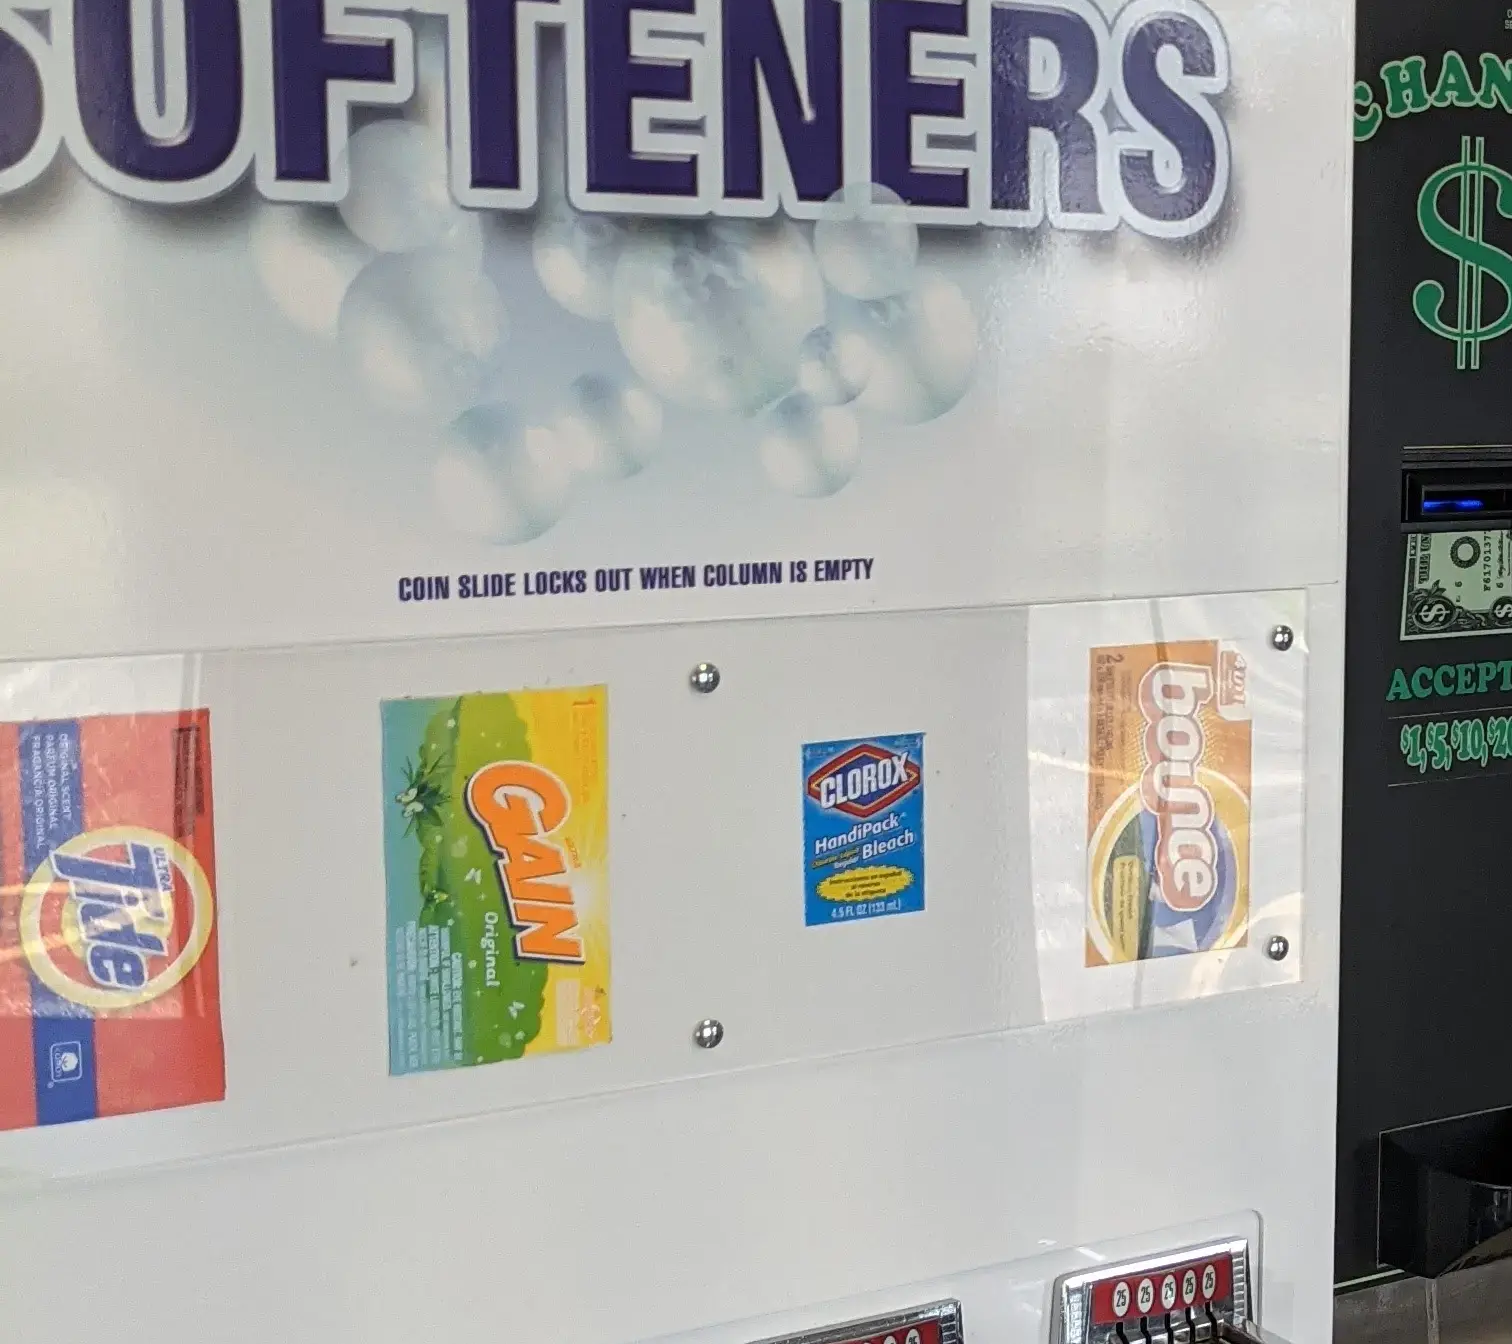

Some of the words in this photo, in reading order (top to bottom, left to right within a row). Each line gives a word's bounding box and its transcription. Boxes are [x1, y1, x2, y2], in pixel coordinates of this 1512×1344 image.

[398, 575, 450, 601] COIN
[458, 572, 516, 599] SLIDE
[524, 569, 587, 596] LOCKS
[594, 567, 633, 593] OUT
[640, 564, 696, 590] WHEN
[703, 560, 782, 588] COLUMN
[789, 559, 806, 583] IS
[814, 557, 875, 582] EMPTY
[47, 780, 59, 829] ORIGINAL
[61, 786, 72, 821] SCENT
[820, 752, 911, 810] CLOROX
[1146, 664, 1216, 906] bounce
[34, 799, 45, 850] ORIGINAL
[815, 812, 900, 854] HandiPack
[862, 830, 914, 860] Bleach
[153, 846, 174, 893] ULTRA
[467, 760, 585, 962] GAIN
[50, 842, 168, 988] Tide
[479, 911, 500, 987] Original
[1116, 1289, 1127, 1308] 25
[1140, 1285, 1151, 1303] 25
[1164, 1281, 1175, 1301] 25
[1184, 1277, 1194, 1296] 25
[1204, 1271, 1214, 1290] 25
